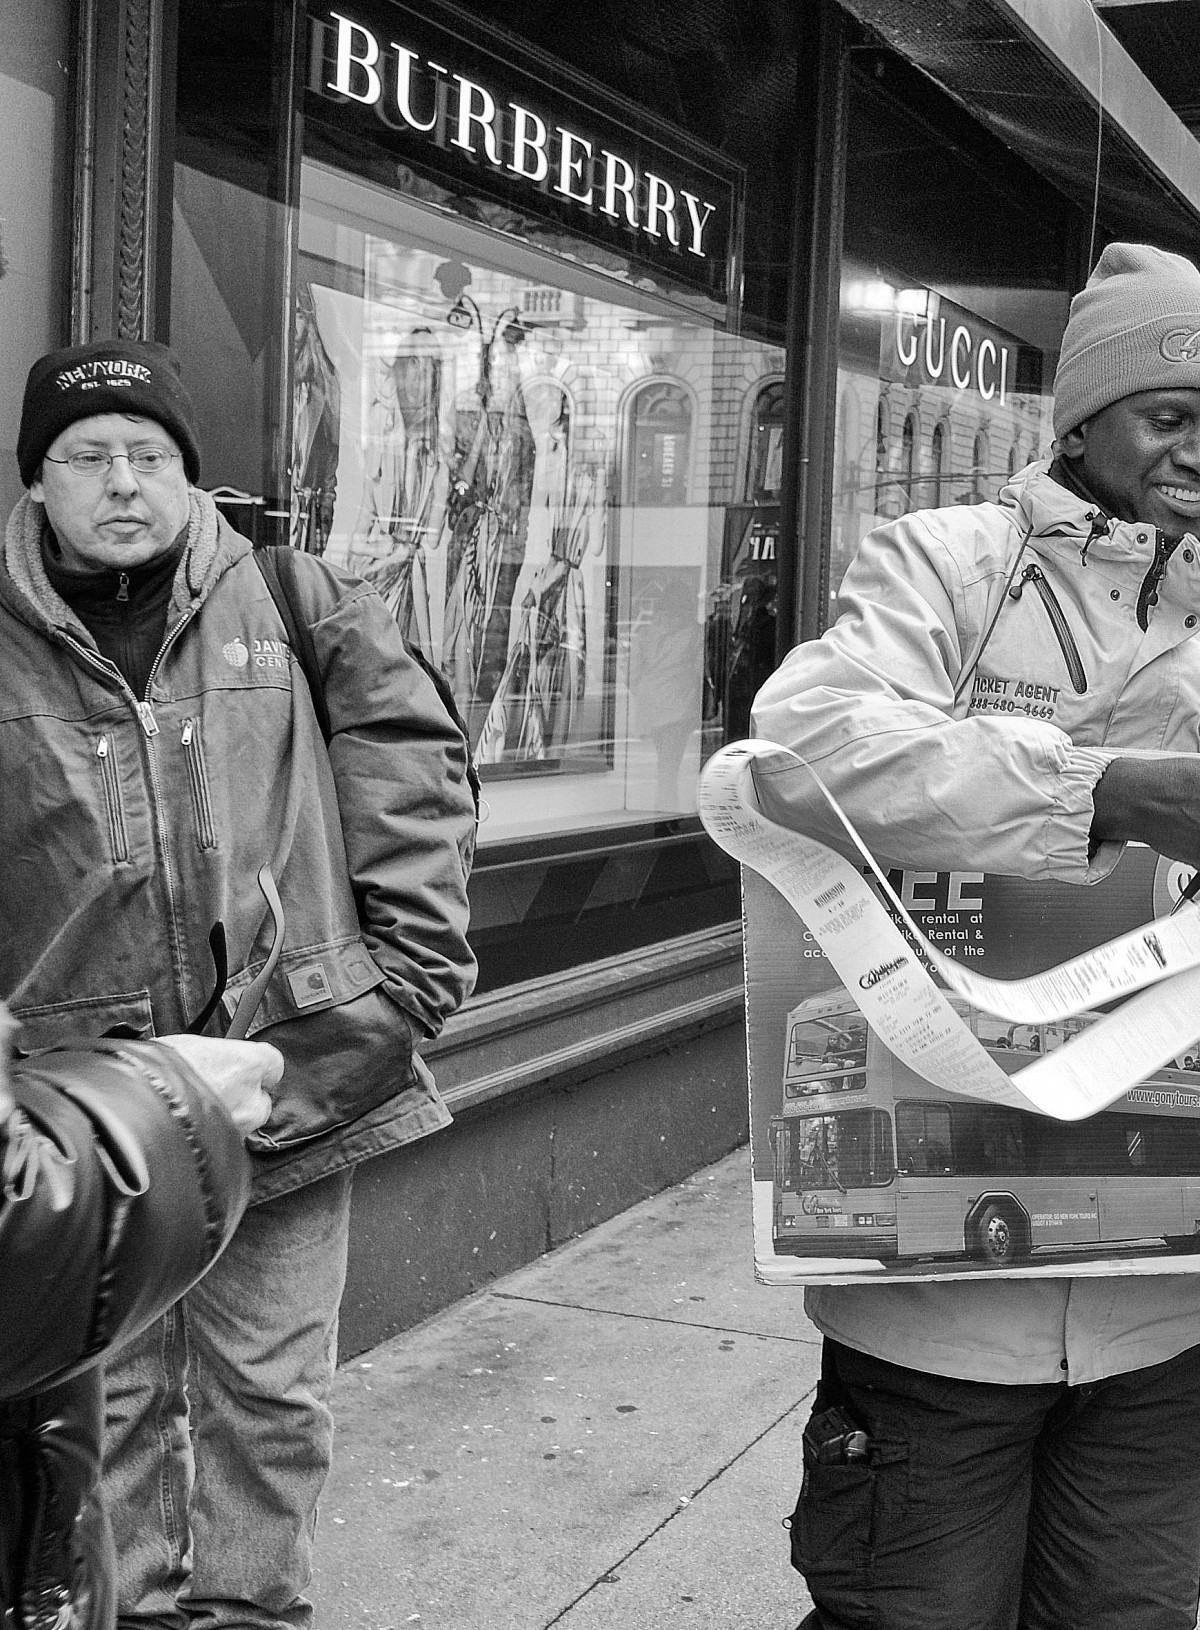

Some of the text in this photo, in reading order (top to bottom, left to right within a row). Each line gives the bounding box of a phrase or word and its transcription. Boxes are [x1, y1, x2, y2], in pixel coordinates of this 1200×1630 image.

[326, 11, 716, 258] BURBERRY
[896, 300, 1008, 407] GUCCI
[55, 360, 152, 390] NEW YORK
[973, 677, 1061, 704] TICKET AGENT
[969, 697, 1055, 720] 888-680-4669
[921, 913, 960, 924] rental
[970, 913, 984, 924] at
[928, 929, 969, 940] Rental
[975, 929, 984, 940] &
[943, 945, 985, 956] of the
